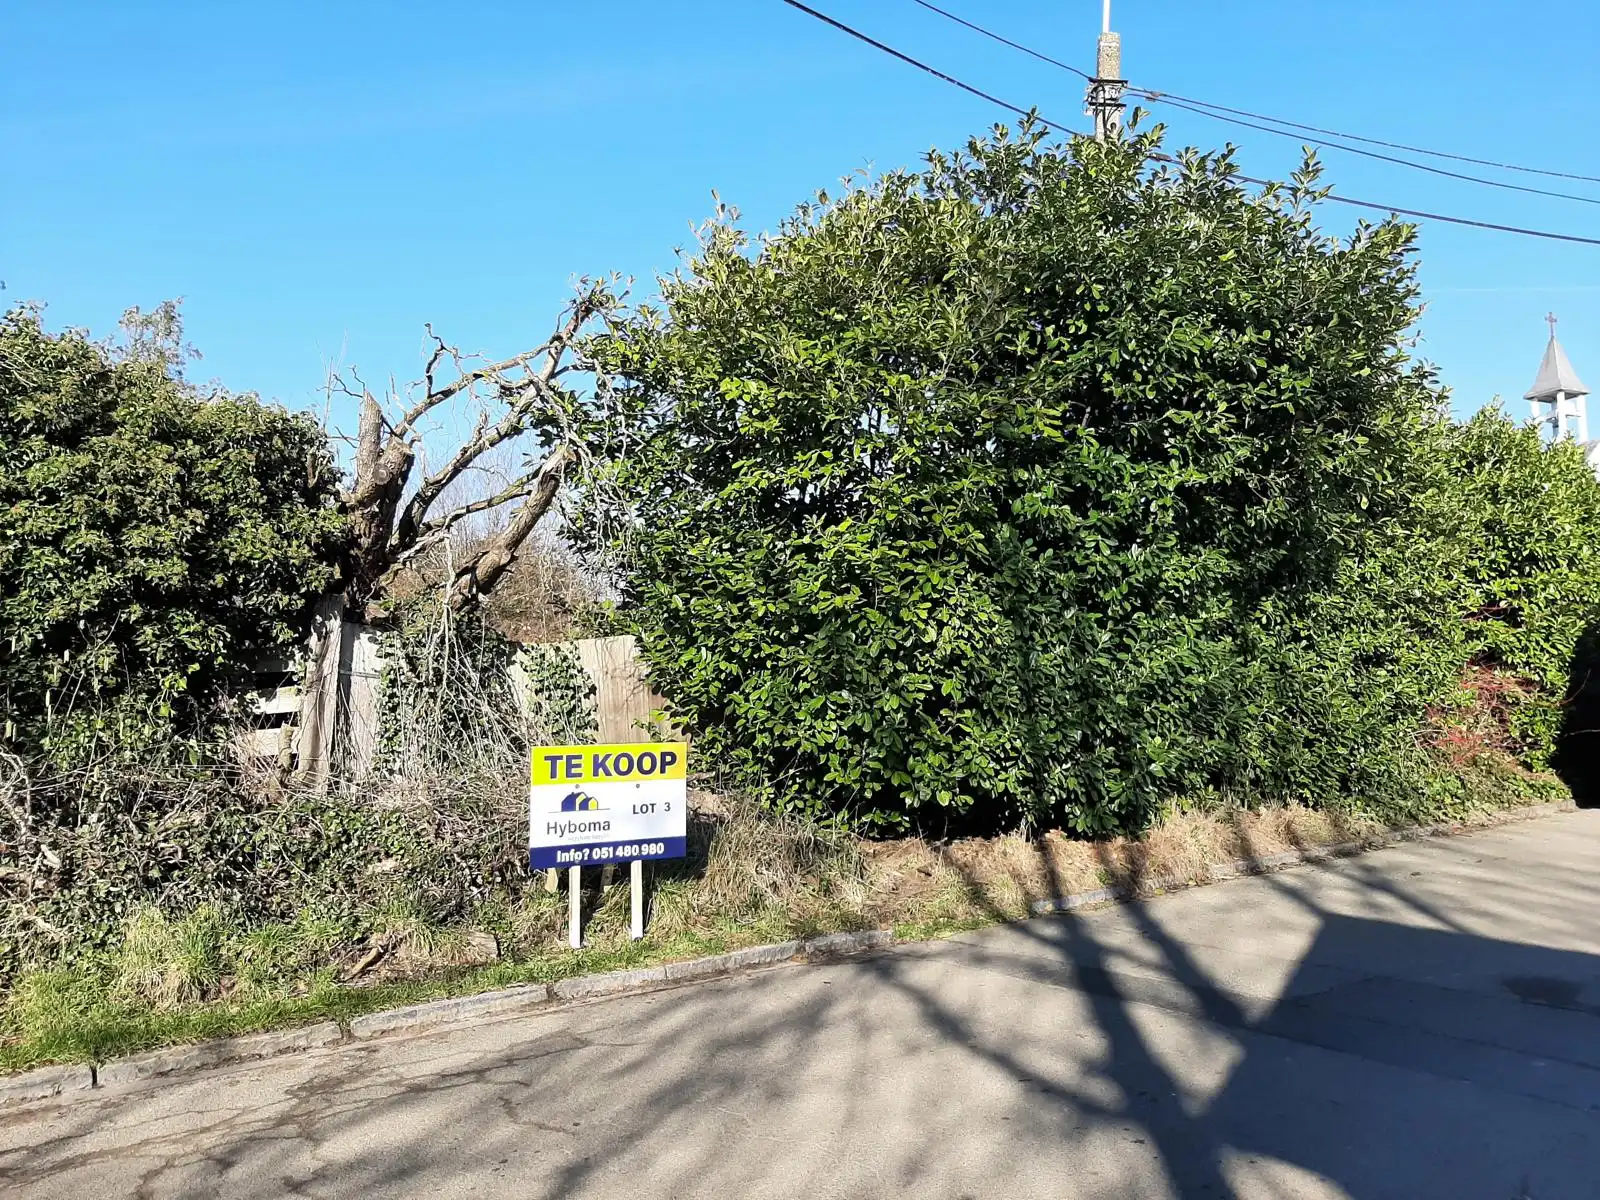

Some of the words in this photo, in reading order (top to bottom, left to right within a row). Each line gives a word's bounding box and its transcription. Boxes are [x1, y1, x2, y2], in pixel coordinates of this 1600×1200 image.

[544, 754, 583, 779] TE
[592, 751, 677, 777] KOOP
[633, 803, 657, 815] LOT
[664, 801, 671, 812] 3
[546, 820, 611, 838] Hyboma
[556, 848, 590, 863] Info?
[592, 847, 614, 860] 051
[615, 844, 640, 857] 480
[641, 842, 665, 856] 980
